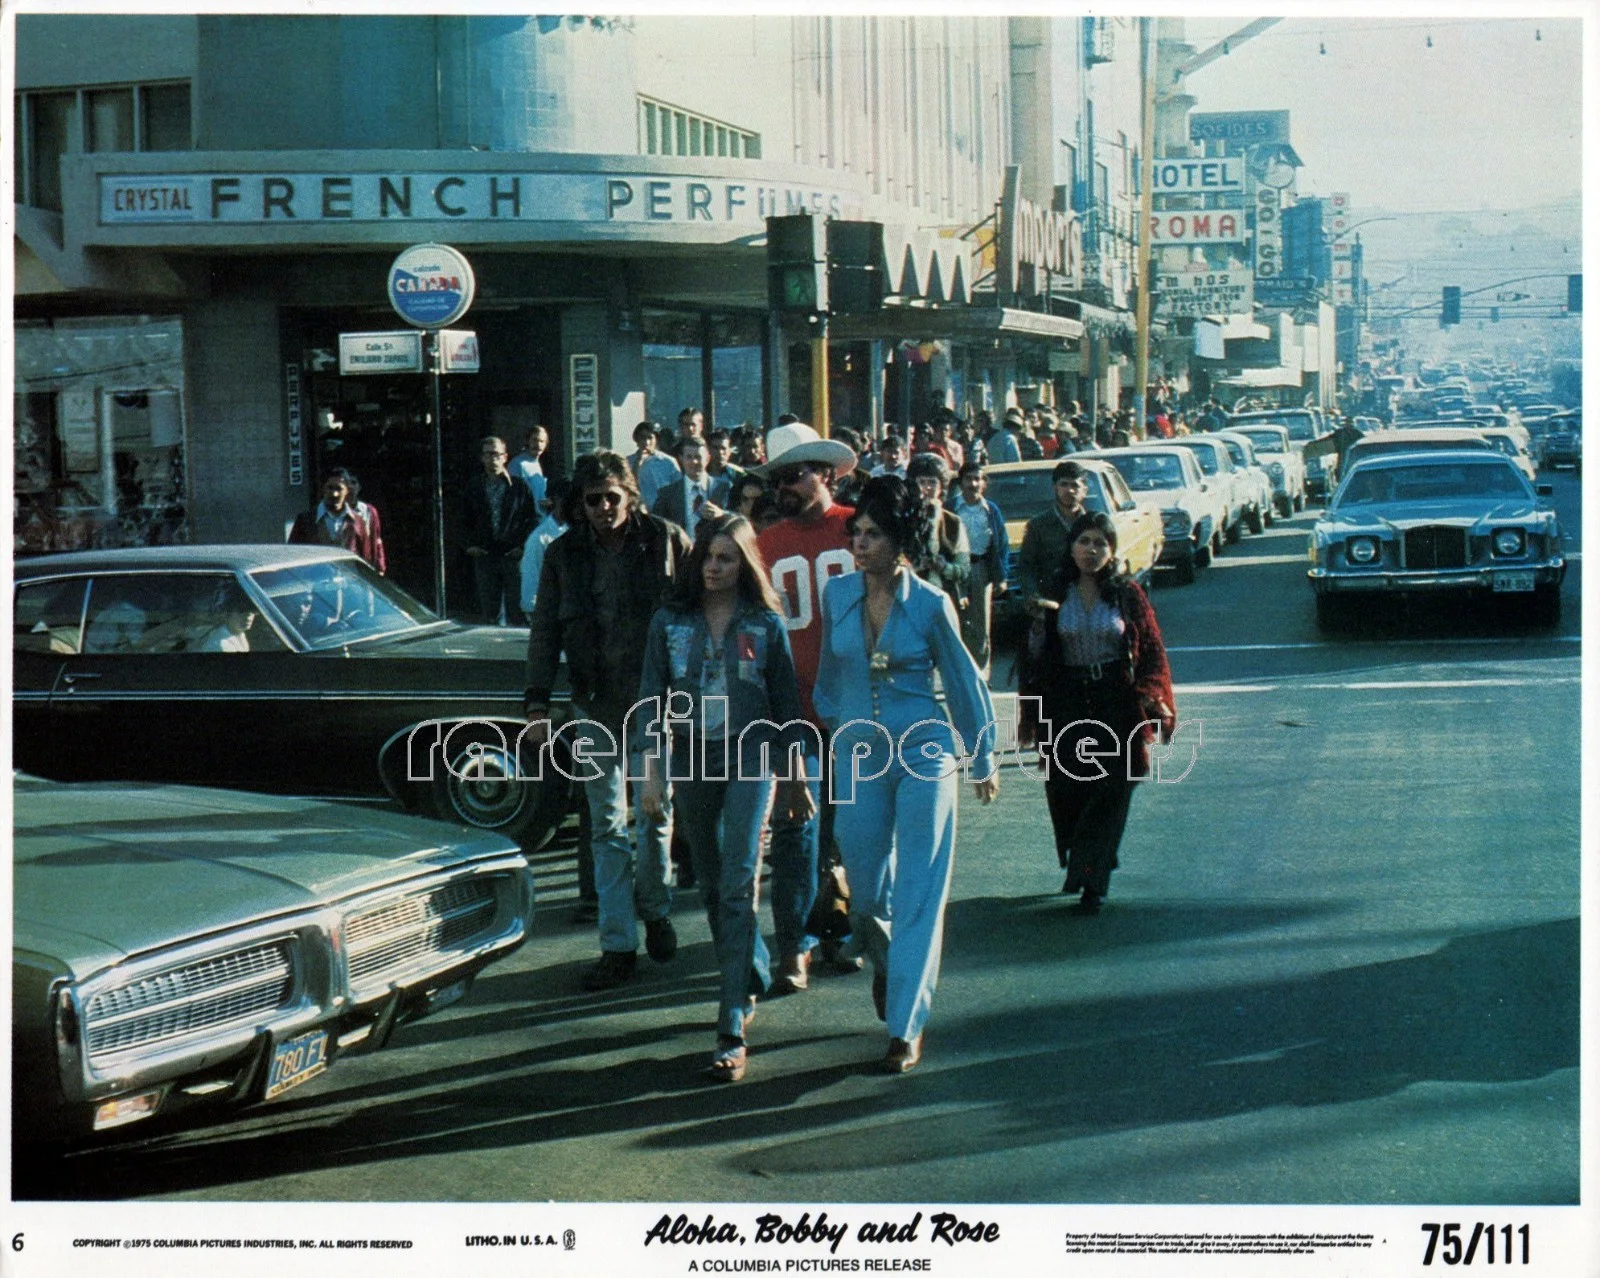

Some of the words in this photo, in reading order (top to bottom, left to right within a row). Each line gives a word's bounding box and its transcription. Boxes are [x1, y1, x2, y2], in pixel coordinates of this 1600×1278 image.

[114, 187, 192, 211] CRYSTAL
[210, 177, 521, 219] FRENCH
[606, 179, 841, 221] PERFUMES
[1172, 302, 1231, 312] FACTORY
[275, 1046, 304, 1082] 780
[11, 1232, 24, 1251] 6
[72, 1239, 121, 1248] COPYRIGHT
[153, 1239, 198, 1248] COLUMBIA
[200, 1239, 242, 1248] PICTURES
[243, 1239, 297, 1249] INDUSTRIES,
[299, 1240, 317, 1249] INC.
[319, 1240, 335, 1248] ALL
[337, 1240, 368, 1249] RIGHTS
[369, 1240, 413, 1249] RESERVED
[644, 1213, 747, 1247] Aloha,
[755, 1212, 848, 1253] Bobby
[857, 1211, 922, 1243] and
[930, 1212, 1001, 1247] Rose
[1421, 1222, 1530, 1266] 75/111
[688, 1260, 698, 1272] A
[702, 1259, 781, 1272] COLUMBIA
[785, 1259, 860, 1272] PICTURES
[864, 1258, 932, 1272] RELEASE
